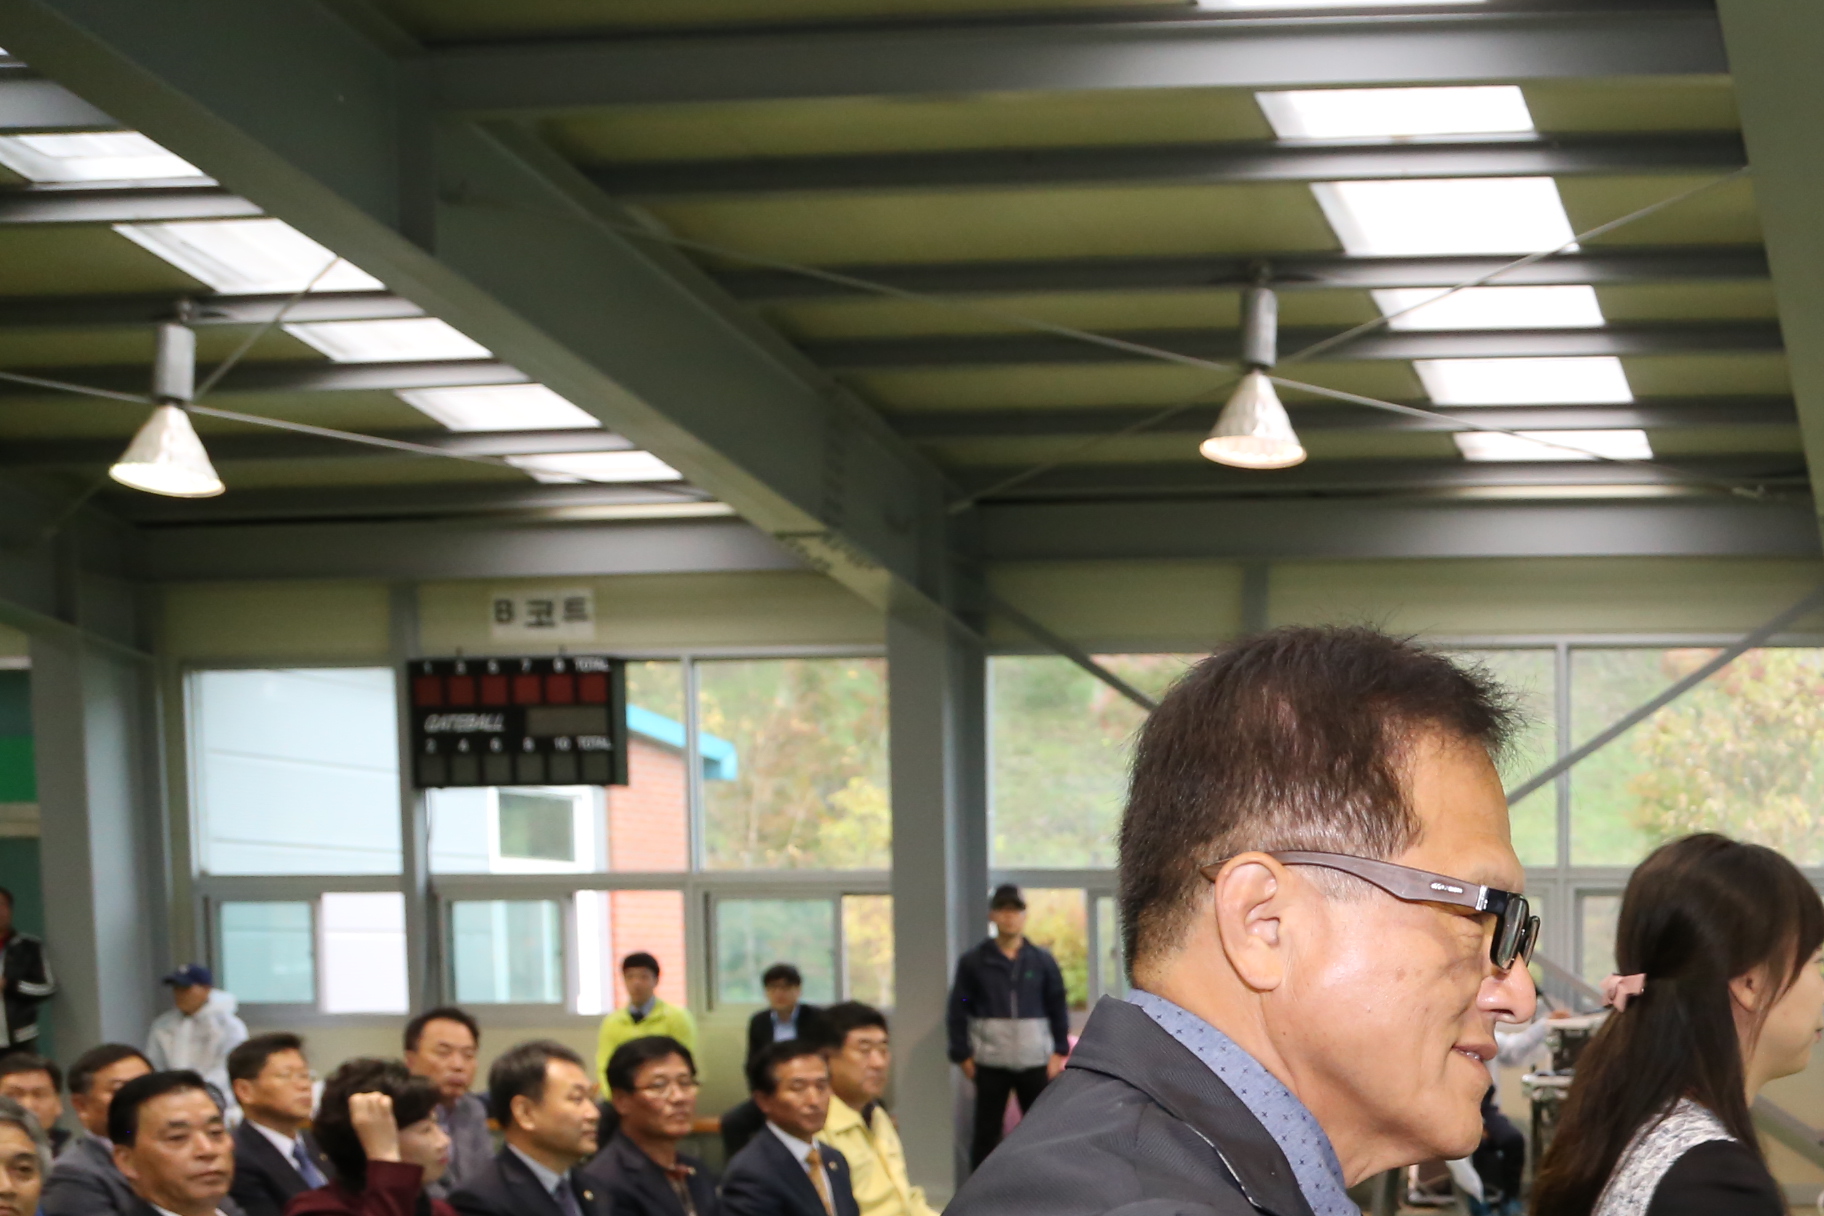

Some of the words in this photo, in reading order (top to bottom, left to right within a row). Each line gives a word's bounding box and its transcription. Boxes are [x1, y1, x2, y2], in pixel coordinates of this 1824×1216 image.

[495, 599, 514, 624] B
[526, 597, 588, 628] 코트
[575, 656, 609, 672] TOTAL
[424, 713, 505, 733] GATEBALL
[554, 736, 572, 753] 10
[577, 736, 612, 752] TOTAL
